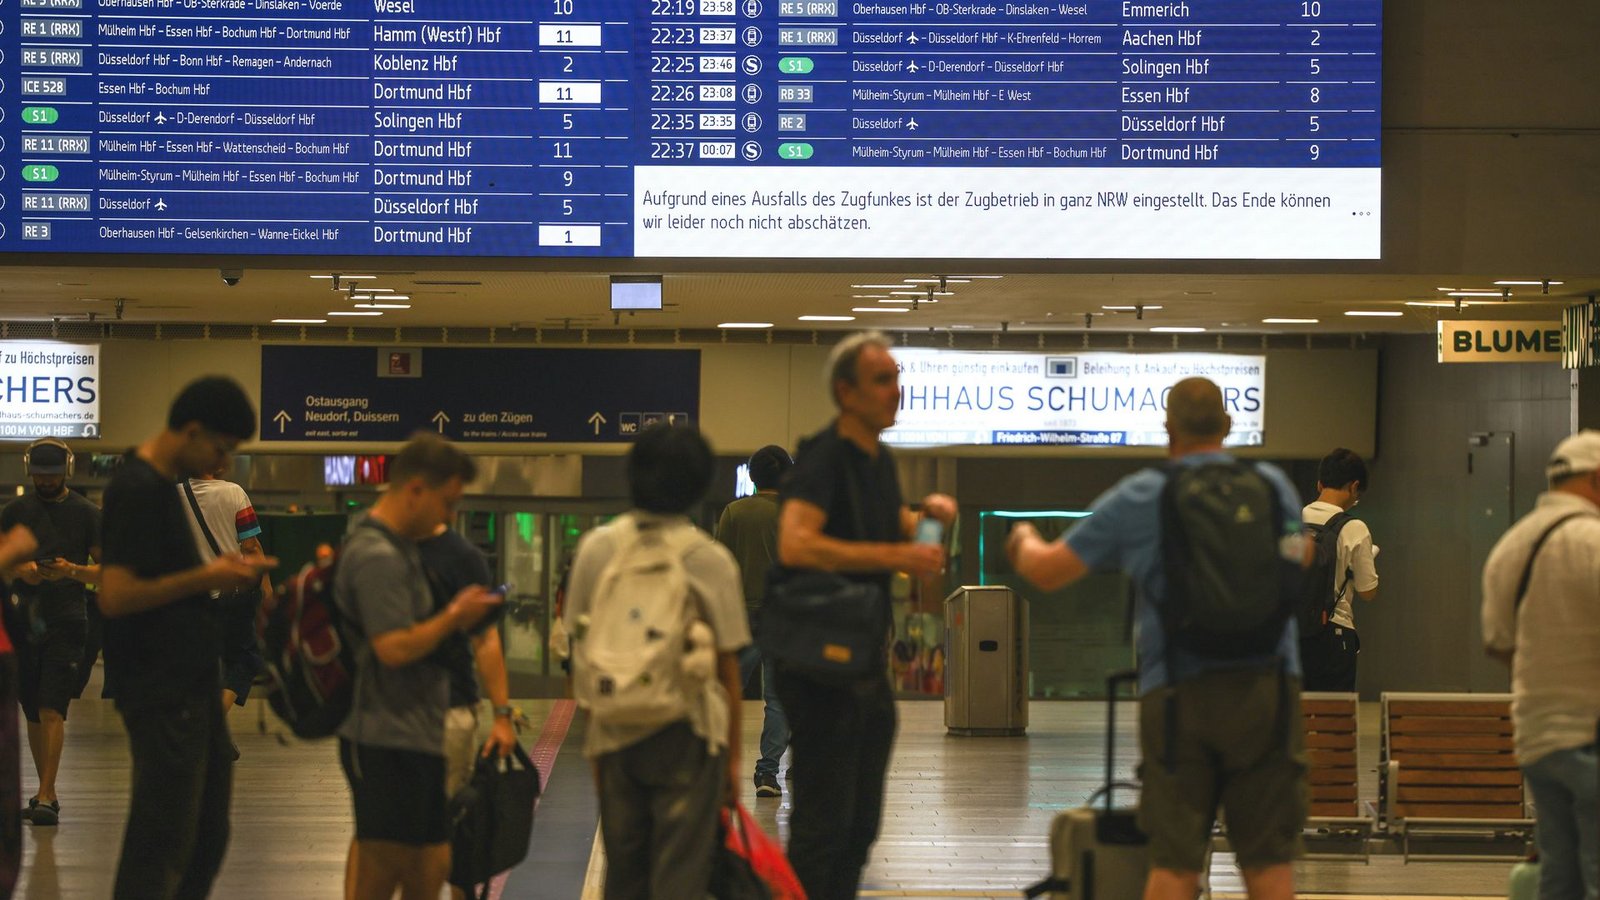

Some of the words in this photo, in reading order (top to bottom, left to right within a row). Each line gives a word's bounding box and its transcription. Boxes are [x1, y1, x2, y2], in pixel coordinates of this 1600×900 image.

[652, 0, 694, 15] 22:19
[703, 1, 733, 12] 23:58
[781, 3, 793, 14] RE
[797, 3, 803, 14] 5
[807, 2, 835, 15] (RRX)
[1123, 1, 1189, 17] Emmerich
[1302, 1, 1320, 17] 10
[24, 22, 36, 34] RE
[40, 23, 46, 34] 1
[51, 22, 79, 36] (RRX)
[374, 25, 416, 42] Hamm
[421, 25, 472, 45] (Westf)
[478, 27, 501, 43] Hbf
[557, 30, 573, 43] 11
[652, 28, 694, 44] 22:23
[703, 30, 732, 40] 23:37
[781, 32, 793, 42] RE
[797, 32, 803, 42] 1
[807, 31, 835, 44] (RRX)
[853, 32, 903, 43] Düsseldorf
[929, 32, 978, 43] Düsseldorf
[982, 32, 998, 43] Hbf
[1008, 32, 1059, 44] K-Ehrenfeld
[1069, 33, 1101, 44] Horrem
[1123, 30, 1173, 45] Aachen
[1178, 30, 1201, 45] Hbf
[1311, 30, 1320, 46] 2
[24, 52, 36, 63] RE
[40, 52, 47, 63] 5
[51, 52, 80, 65] (RRX)
[374, 54, 428, 71] Koblenz
[434, 55, 457, 71] Hbf
[564, 56, 573, 72] 2
[652, 57, 694, 72] 22:25
[703, 59, 732, 69] 23:46
[789, 61, 801, 71] S1
[1122, 59, 1181, 78] Solingen
[1186, 59, 1209, 74] Hbf
[1311, 59, 1320, 74] 5
[24, 81, 39, 92] ICE
[43, 81, 63, 93] 528
[374, 83, 443, 99] Dortmund
[448, 84, 472, 100] Hbf
[557, 87, 573, 100] 11
[651, 85, 694, 101] 22:26
[703, 87, 732, 98] 23:08
[781, 89, 794, 99] RB
[798, 89, 810, 99] 33
[1122, 87, 1161, 103] Essen
[1166, 87, 1189, 103] Hbf
[1310, 87, 1320, 103] 8
[33, 110, 46, 121] S1
[374, 112, 433, 132] Solingen
[438, 113, 462, 128] Hbf
[563, 114, 572, 129] 5
[652, 114, 694, 130] 22:35
[703, 116, 732, 126] 23:35
[781, 117, 793, 128] RE
[797, 117, 803, 128] 2
[853, 117, 902, 129] Düsseldorf
[1122, 116, 1196, 131] Düsseldorf
[1202, 116, 1225, 131] Hbf
[1310, 116, 1319, 131] 5
[25, 139, 37, 150] RE
[41, 139, 54, 150] 11
[59, 139, 87, 152] (RRX)
[374, 140, 443, 157] Dortmund
[448, 141, 471, 157] Hbf
[554, 142, 572, 158] 11
[651, 142, 694, 158] 22:37
[703, 144, 732, 155] 00:07
[789, 147, 802, 156] S1
[1122, 144, 1190, 160] Dortmund
[1195, 145, 1218, 160] Hbf
[1310, 145, 1319, 160] 9
[33, 168, 47, 179] S1
[374, 169, 443, 185] Dortmund
[448, 170, 472, 186] Hbf
[563, 171, 573, 186] 9
[25, 197, 37, 208] RE
[41, 197, 54, 208] 11
[59, 197, 87, 210] (RRX)
[374, 198, 449, 214] Düsseldorf
[455, 199, 478, 214] Hbf
[563, 199, 572, 215] 5
[643, 190, 706, 209] Aufgrund
[712, 192, 746, 206] eines
[752, 190, 807, 206] Ausfalls
[812, 191, 836, 206] des
[841, 191, 911, 210] Zugfunkes
[916, 193, 932, 207] ist
[938, 191, 959, 207] der
[965, 191, 1039, 211] Zugbetrieb
[1044, 193, 1055, 207] in
[1060, 196, 1092, 211] ganz
[1098, 192, 1128, 207] NRW
[1133, 192, 1207, 211] eingestellt.
[1212, 192, 1237, 207] Das
[1243, 192, 1276, 207] Ende
[1281, 192, 1330, 207] können
[643, 215, 663, 229] wir
[668, 214, 705, 229] leider
[711, 214, 744, 229] noch
[749, 214, 782, 229] nicht
[788, 214, 870, 230] abschätzen.
[25, 226, 37, 237] RE
[42, 226, 48, 237] 3
[100, 226, 155, 238] Oberhausen
[158, 227, 175, 238] Hbf
[185, 227, 248, 239] Gelsenkirchen
[258, 228, 319, 240] Wanne-Eickel
[322, 229, 339, 240] Hbf
[374, 226, 443, 243] Dortmund
[448, 227, 471, 243] Hbf
[565, 230, 573, 243] 1
[5, 354, 17, 364] zu
[20, 351, 94, 368] Höchstpreisen
[306, 395, 368, 408] Ostausgang
[305, 410, 351, 422] Neudorf,
[354, 411, 400, 422] Duissern
[464, 414, 476, 422] zu
[478, 412, 498, 422] den
[500, 412, 533, 424] Zügen
[54, 425, 74, 436] HBF
[622, 423, 637, 432] WC
